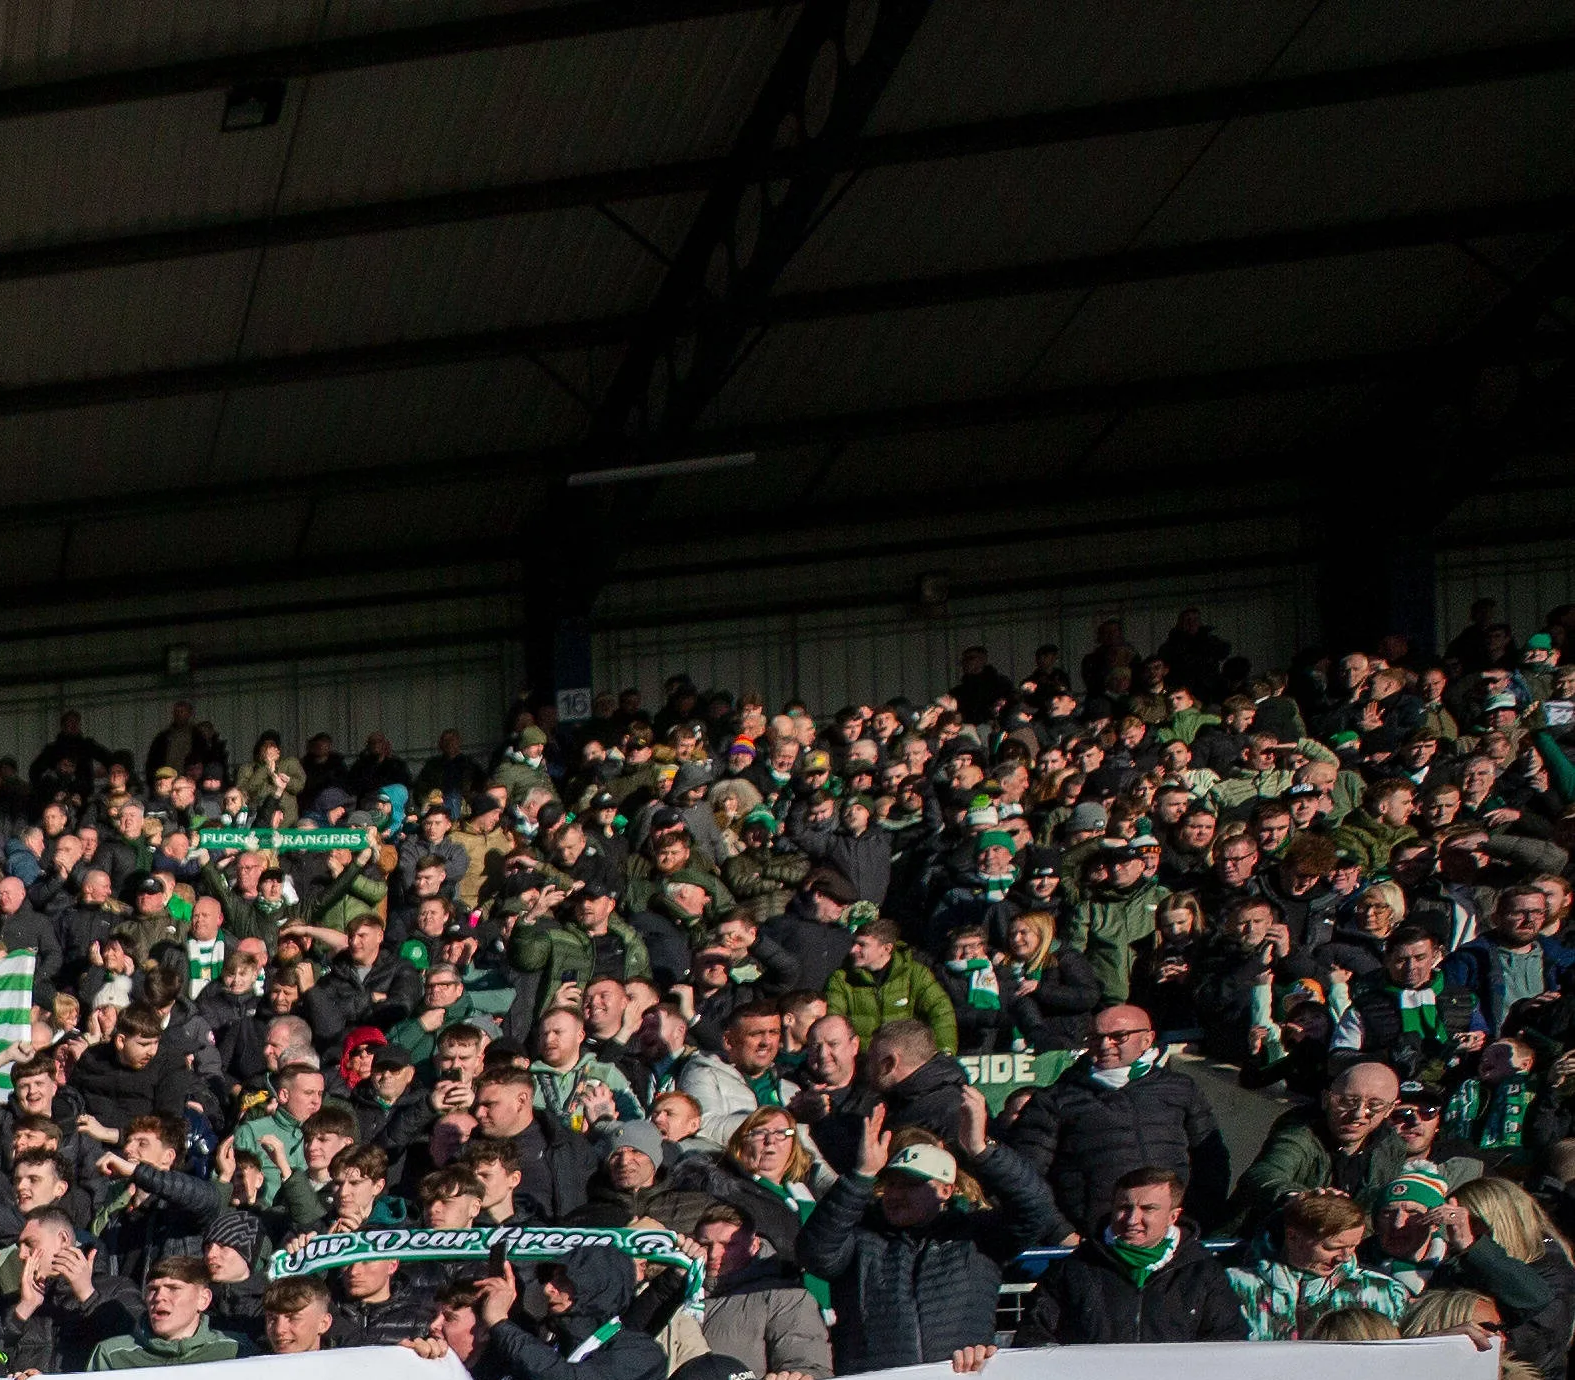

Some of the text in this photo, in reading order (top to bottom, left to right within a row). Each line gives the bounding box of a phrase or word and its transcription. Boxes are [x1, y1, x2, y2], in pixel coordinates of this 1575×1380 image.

[202, 832, 362, 846] FUCK RANGERS
[958, 1053, 1037, 1085] SIDE
[367, 1228, 481, 1252] Dear
[487, 1226, 613, 1253] Green
